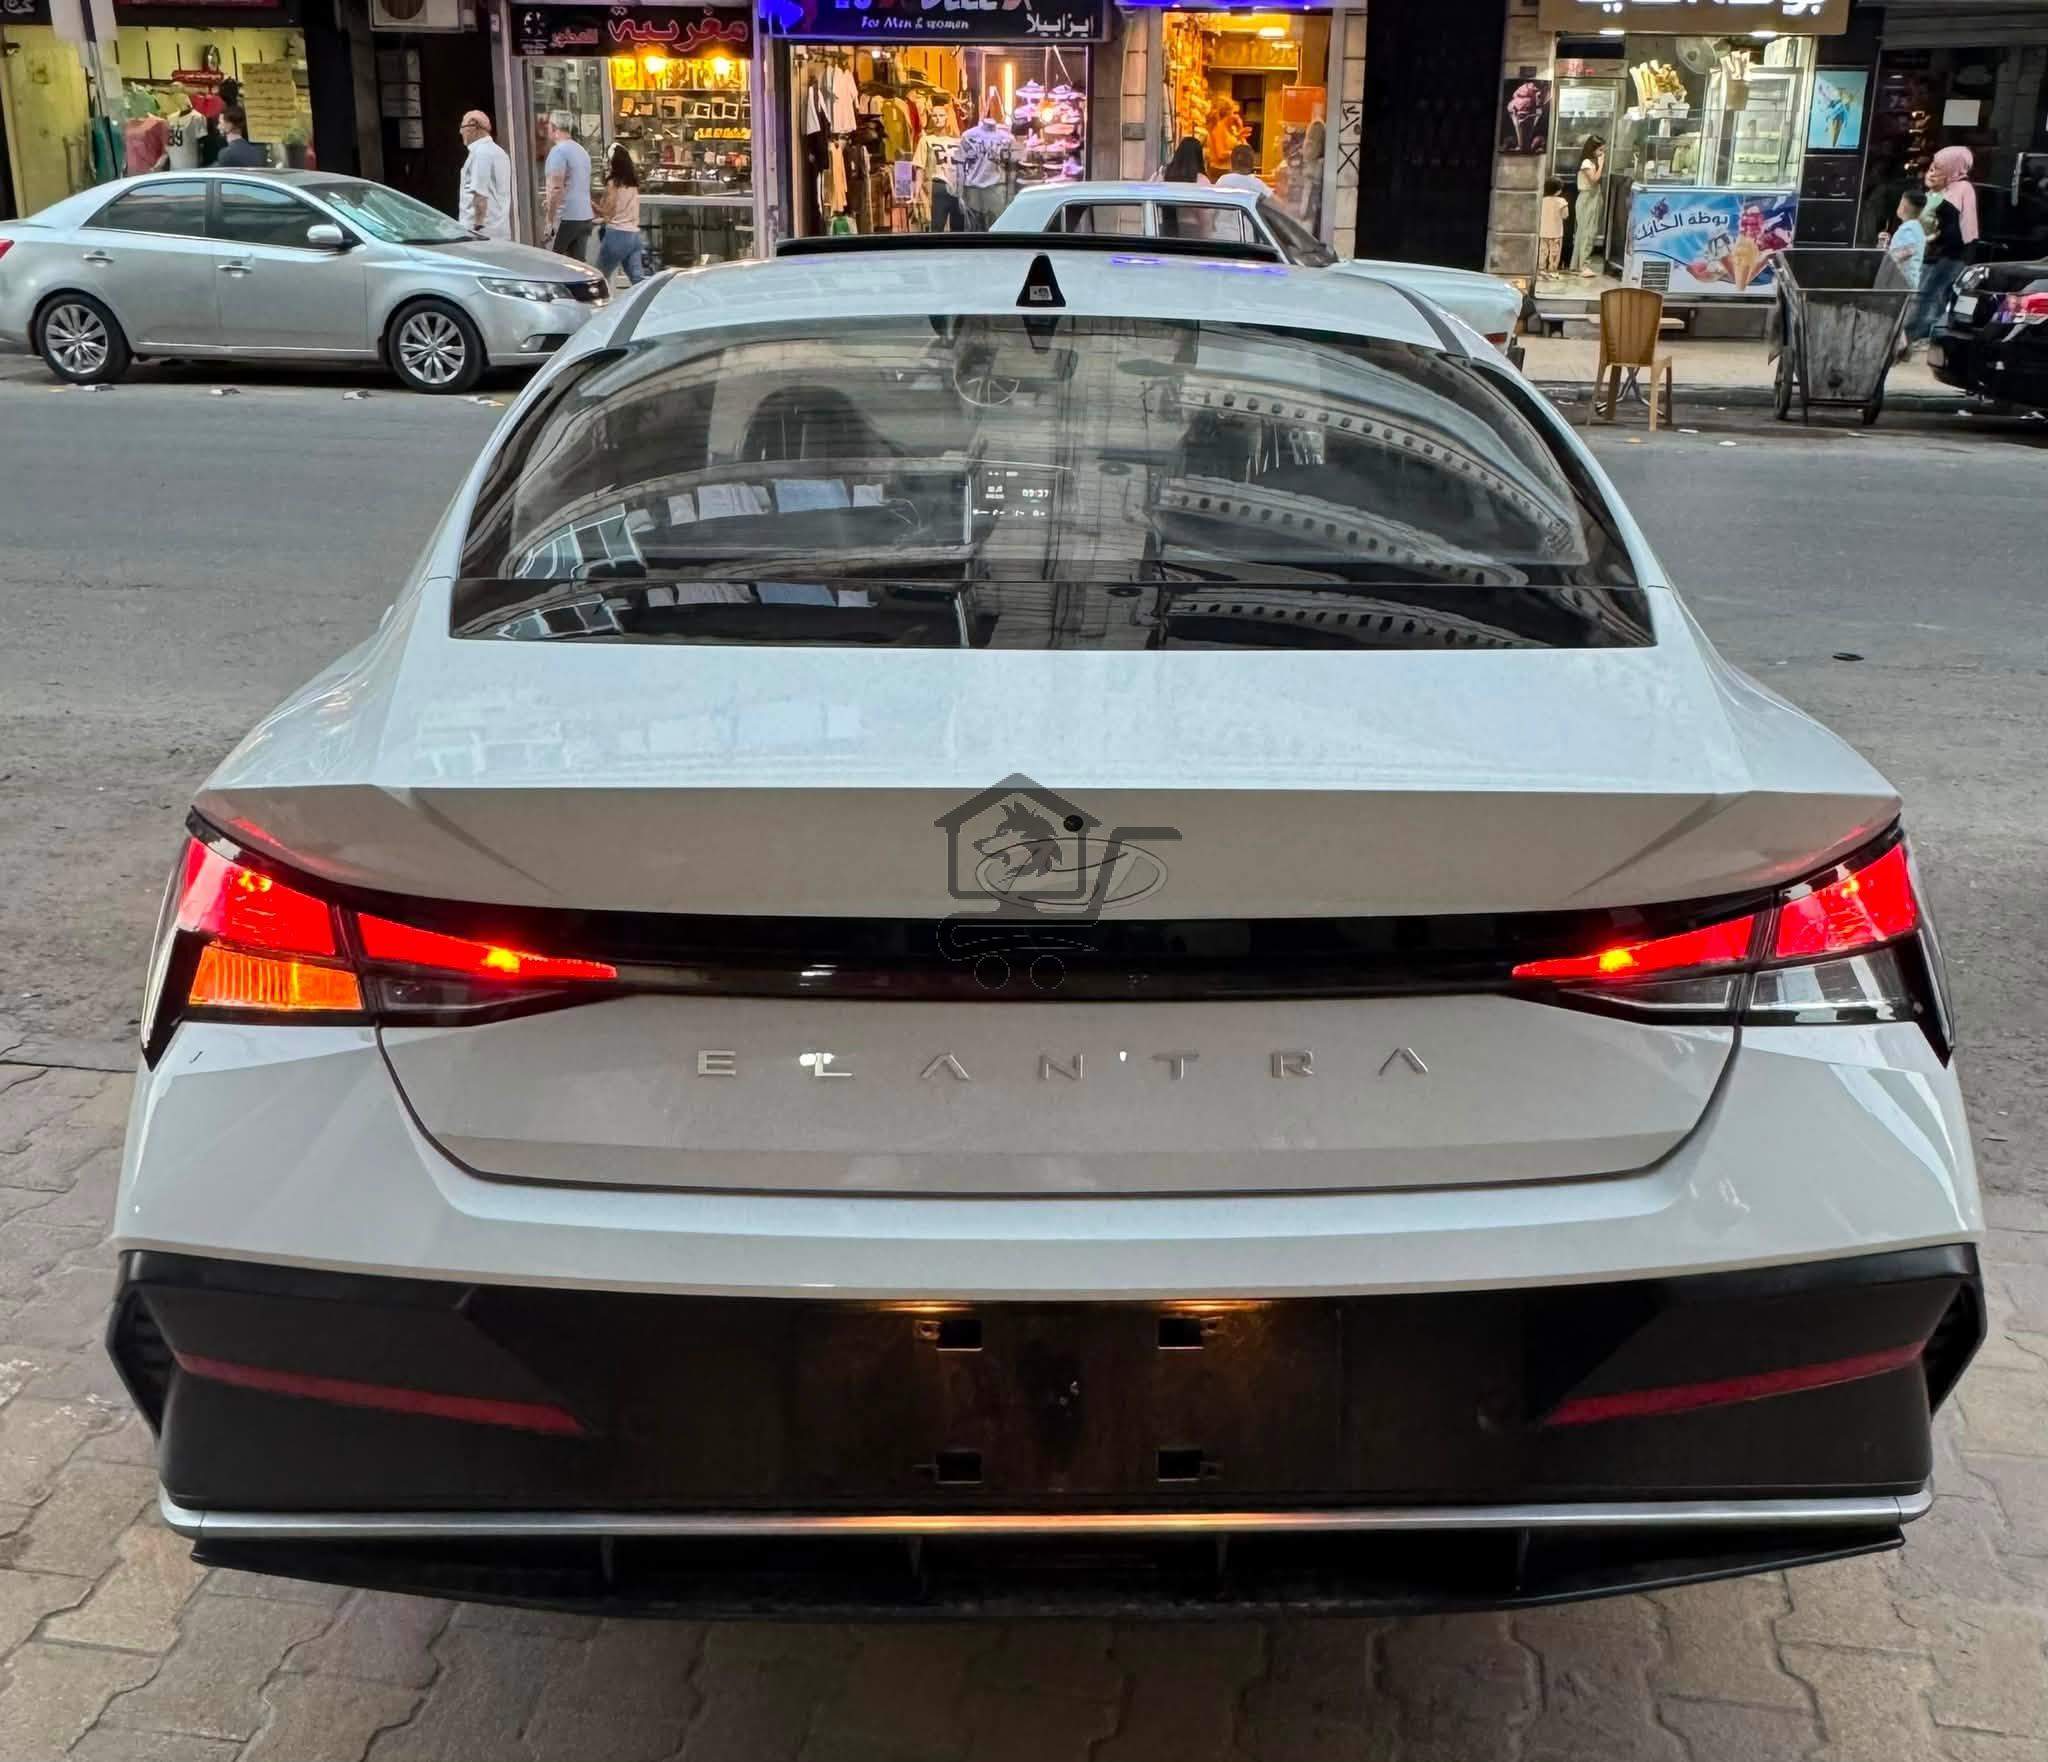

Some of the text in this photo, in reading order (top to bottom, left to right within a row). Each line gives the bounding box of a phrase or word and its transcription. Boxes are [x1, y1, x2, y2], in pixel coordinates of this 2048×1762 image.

[607, 6, 748, 51] مغربية
[861, 16, 880, 29] For
[884, 16, 912, 29] Men
[927, 19, 969, 30] women
[698, 1048, 1429, 1080] ELANTRA
